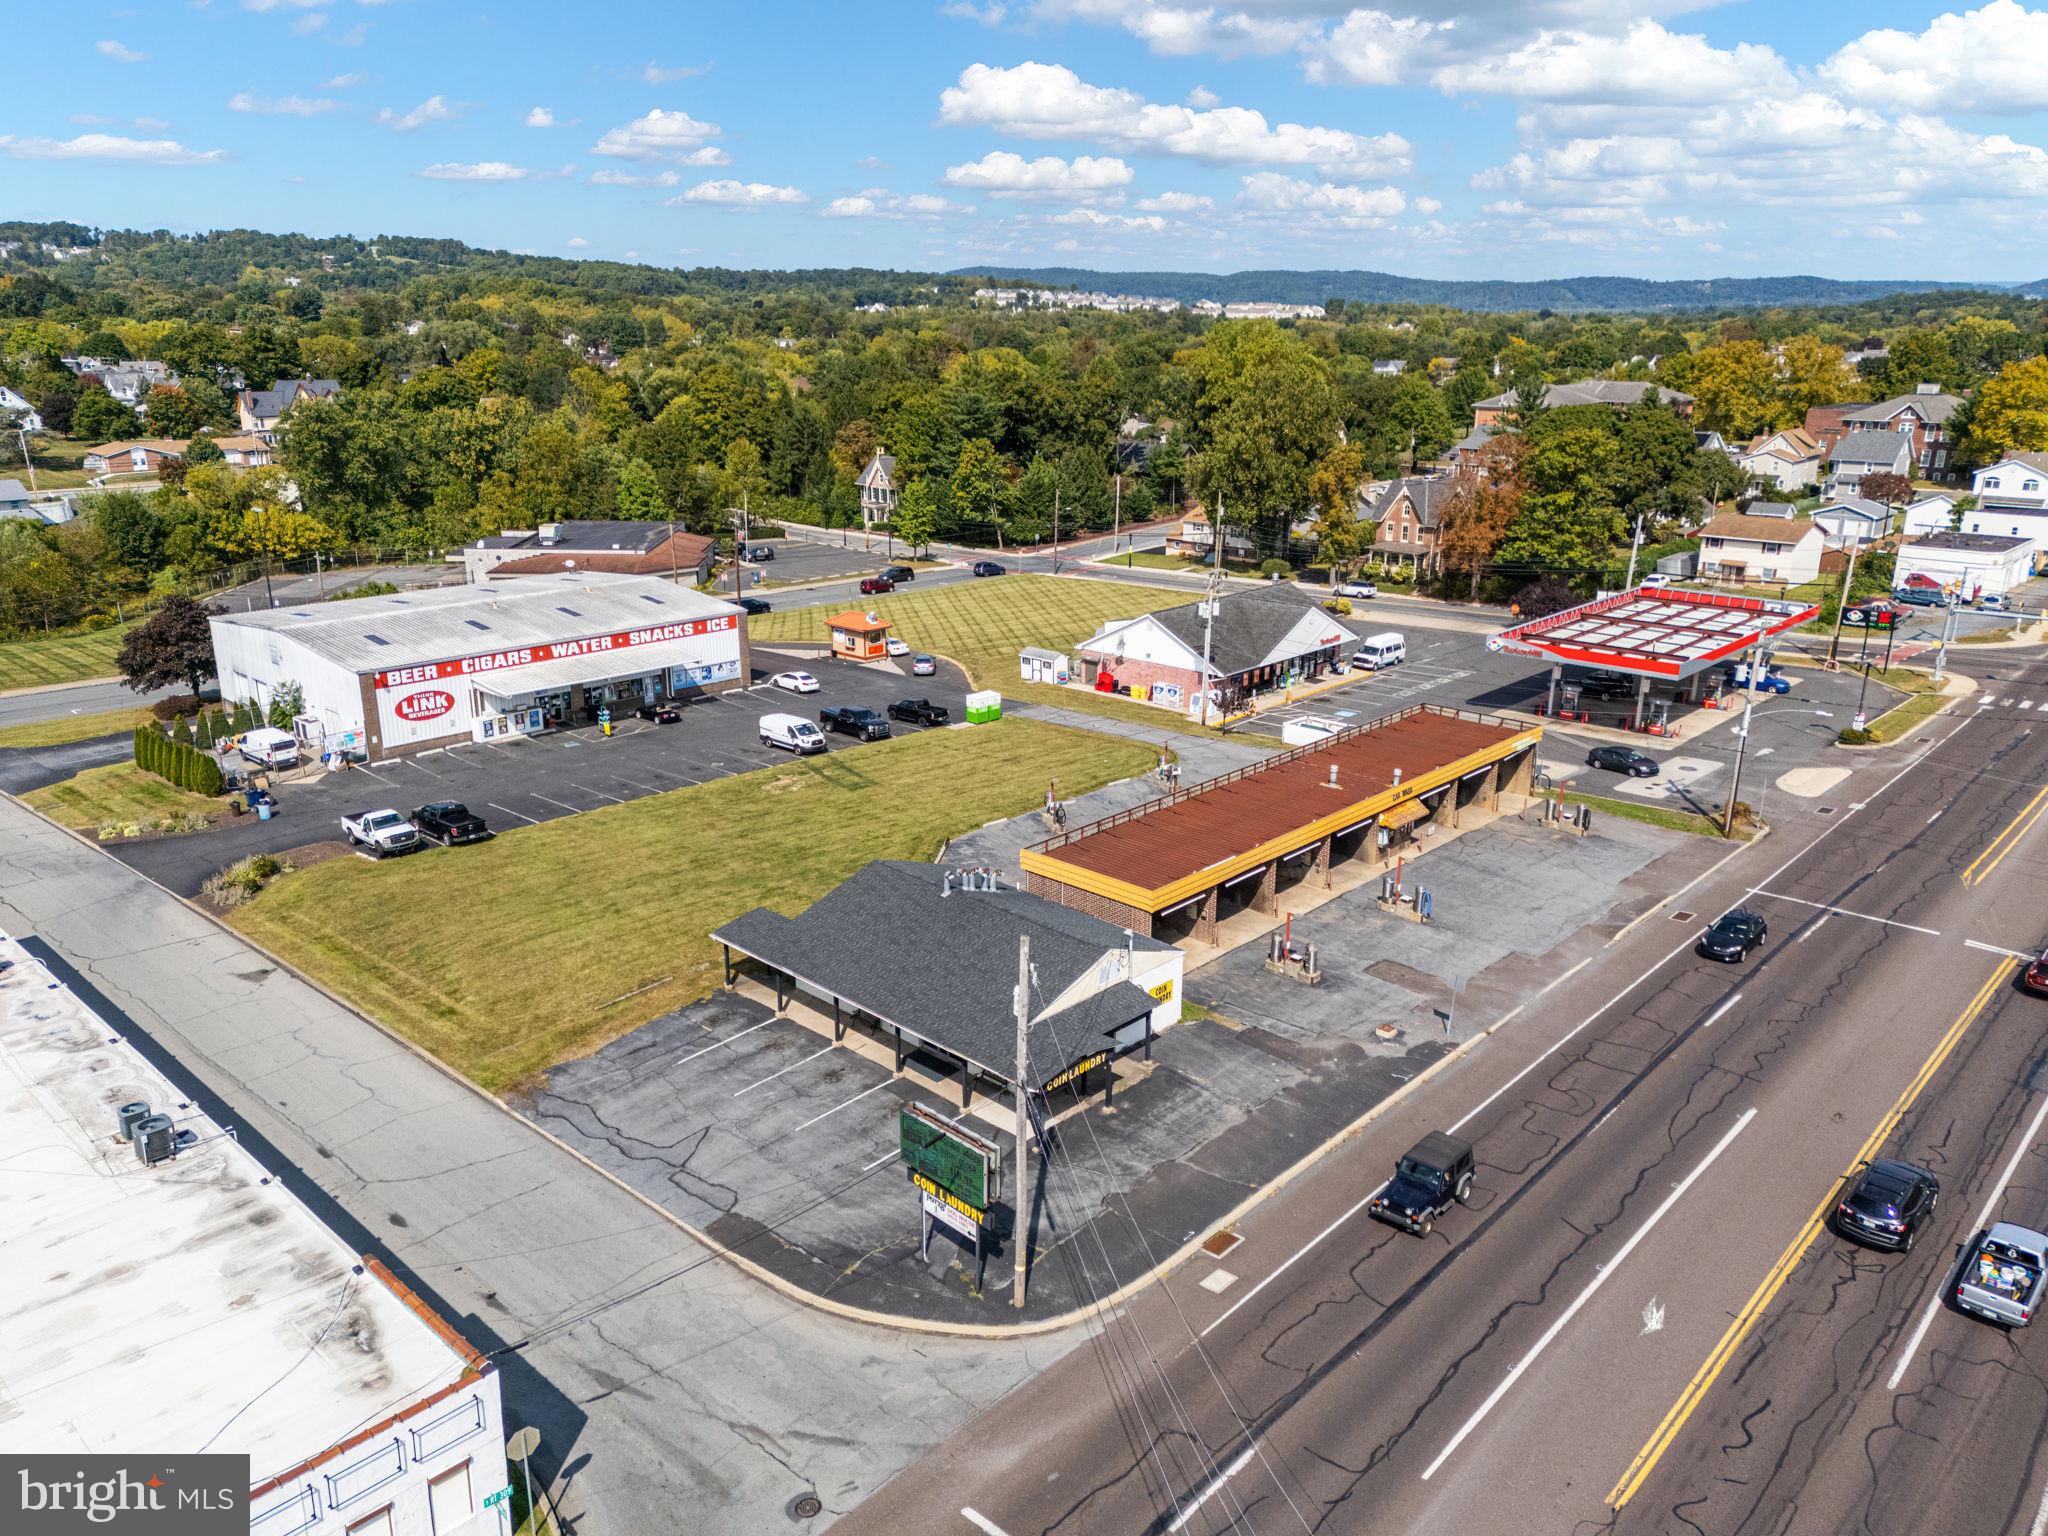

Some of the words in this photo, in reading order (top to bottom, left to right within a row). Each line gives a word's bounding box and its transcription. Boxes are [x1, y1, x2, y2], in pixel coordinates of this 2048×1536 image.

[387, 665, 438, 686] BEER
[461, 649, 532, 672] CIGARS
[550, 636, 613, 658] WATER
[629, 623, 694, 645] SNACKS
[706, 617, 729, 632] ICE
[401, 694, 449, 714] LINK
[413, 692, 434, 700] THINK
[408, 707, 446, 719] BEVERAGES
[1156, 984, 1168, 996] COIN
[1046, 1071, 1068, 1091] COIN
[1069, 1052, 1107, 1081] LAUNDRY
[913, 1174, 937, 1196] COIN
[940, 1188, 985, 1225] LAUNDRY
[490, 1496, 497, 1504] RT
